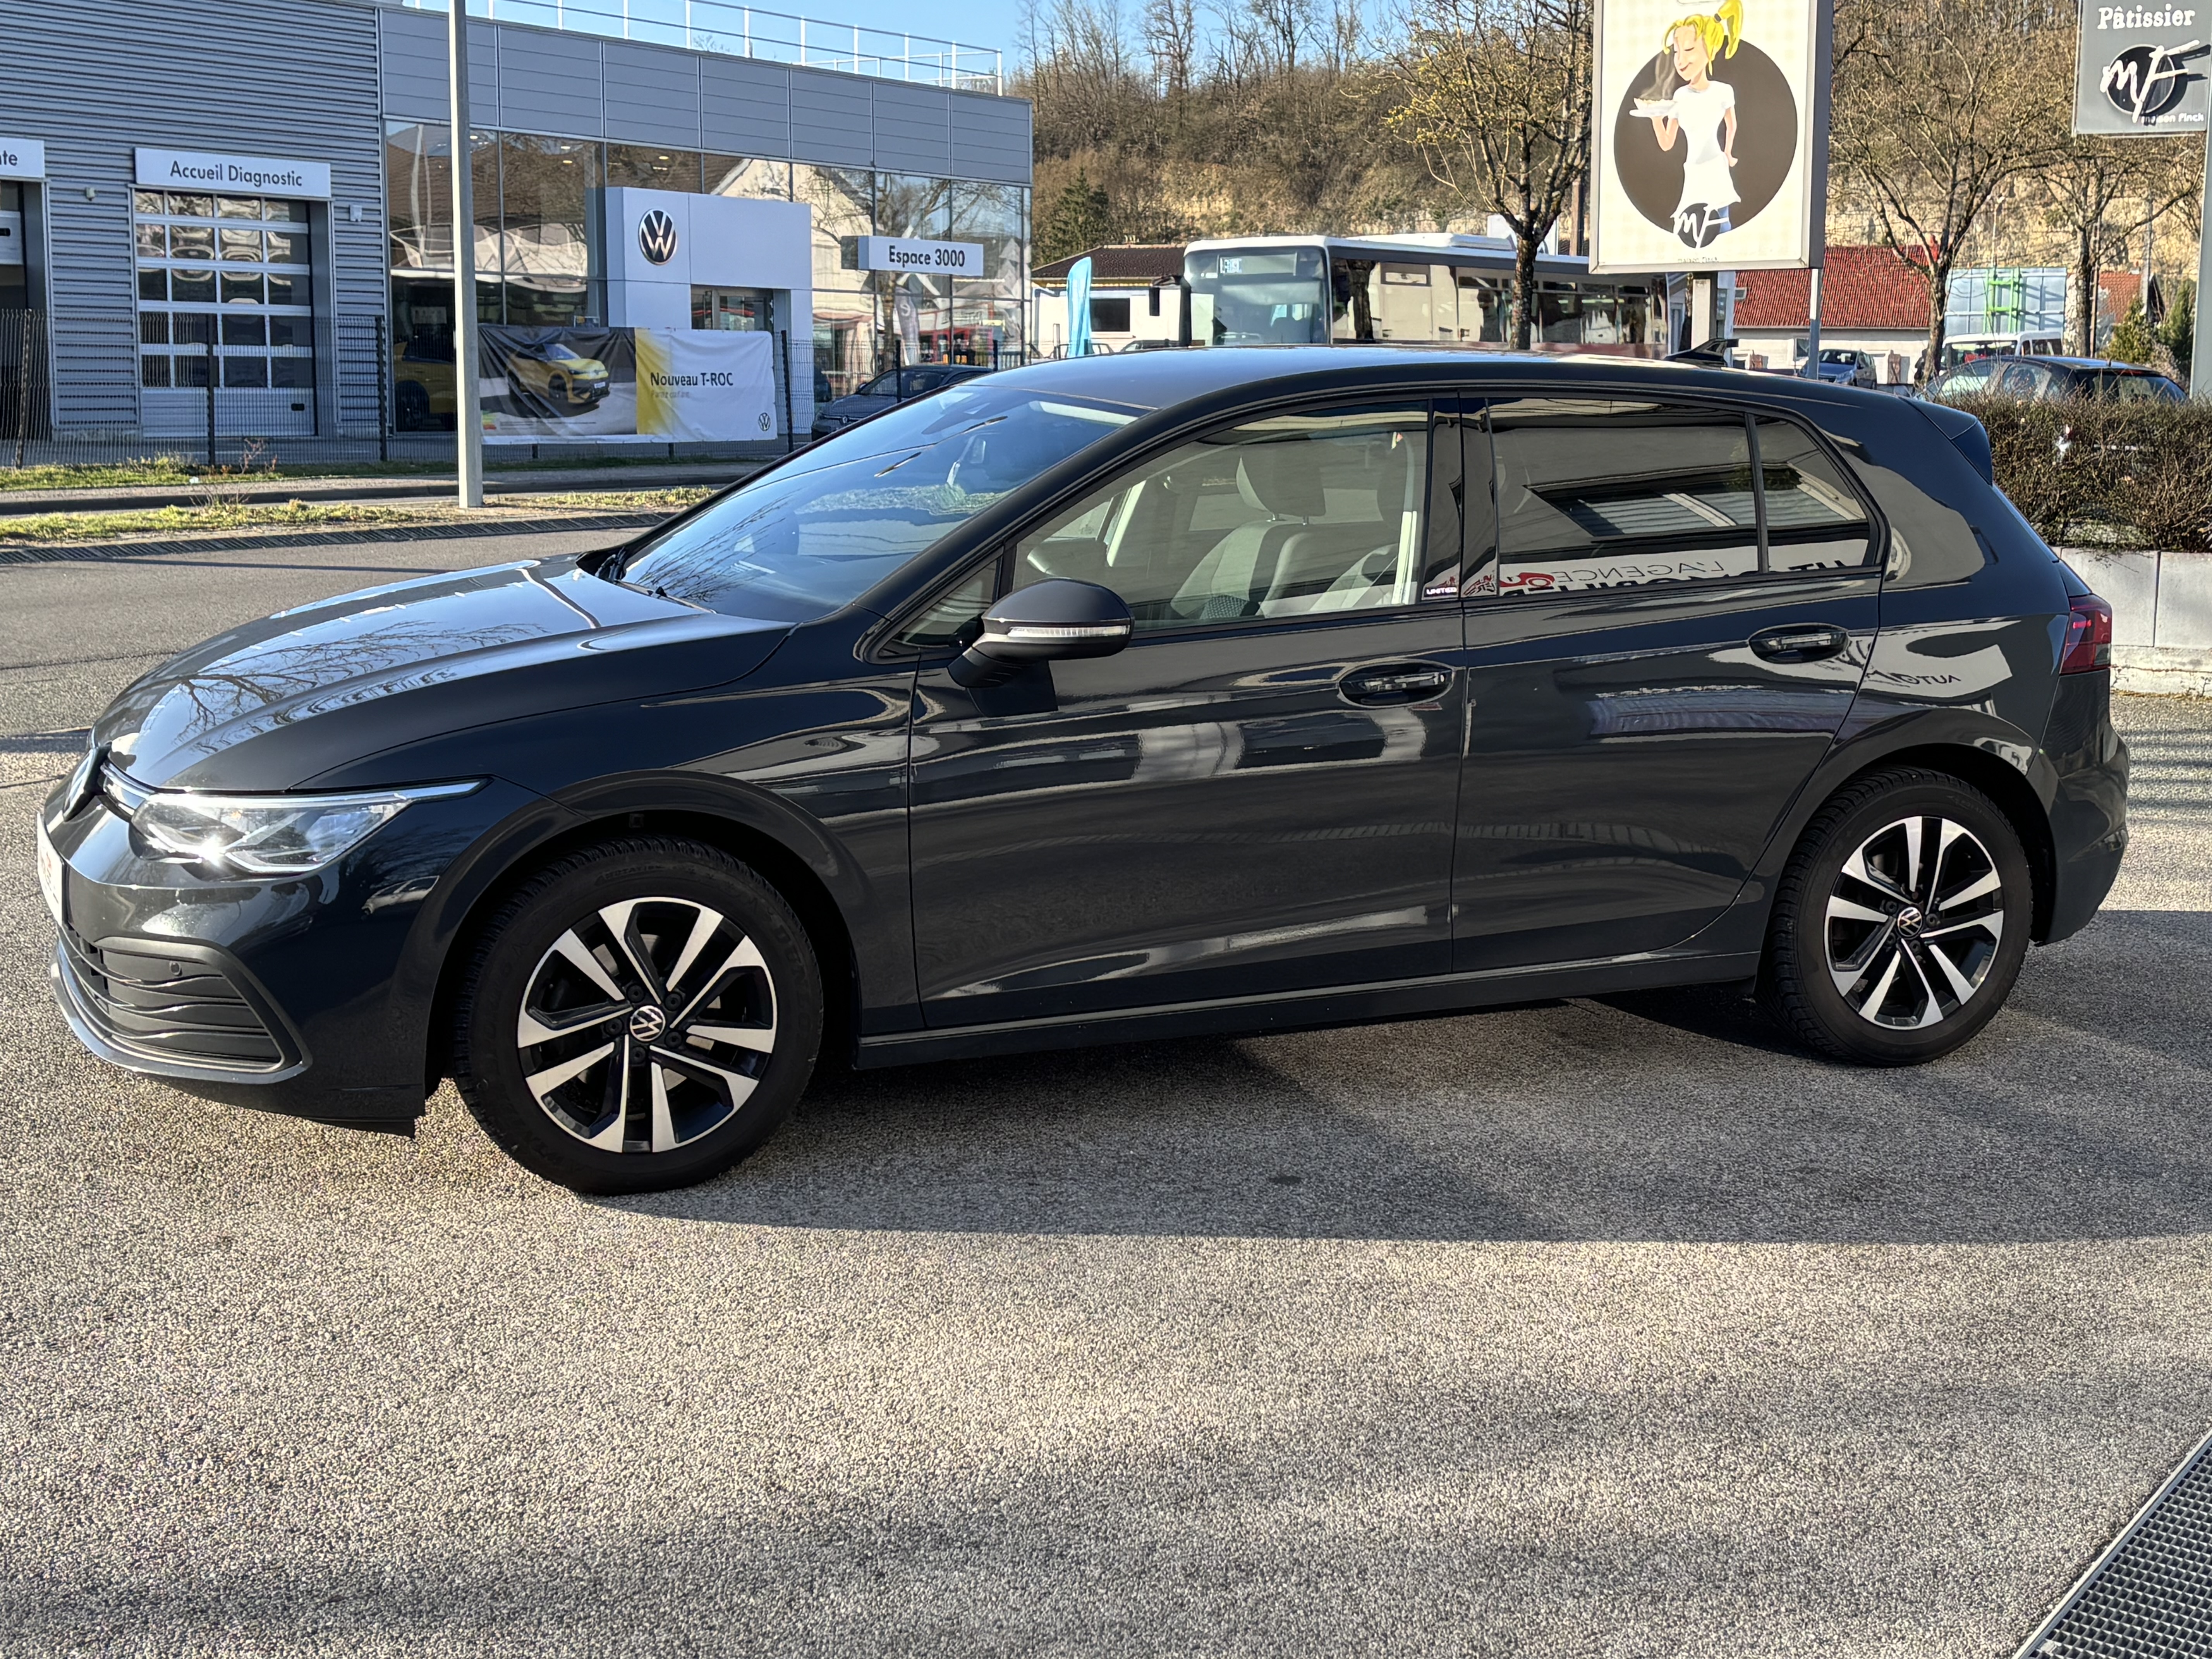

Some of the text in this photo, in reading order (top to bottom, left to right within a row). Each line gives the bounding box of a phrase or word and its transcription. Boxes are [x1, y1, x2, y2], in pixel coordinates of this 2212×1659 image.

[2097, 3, 2195, 29] Pâtissier
[170, 160, 302, 187] Accueil Diagnostic
[889, 245, 965, 268] Espace 3000
[651, 372, 733, 386] Nouveau T-ROC
